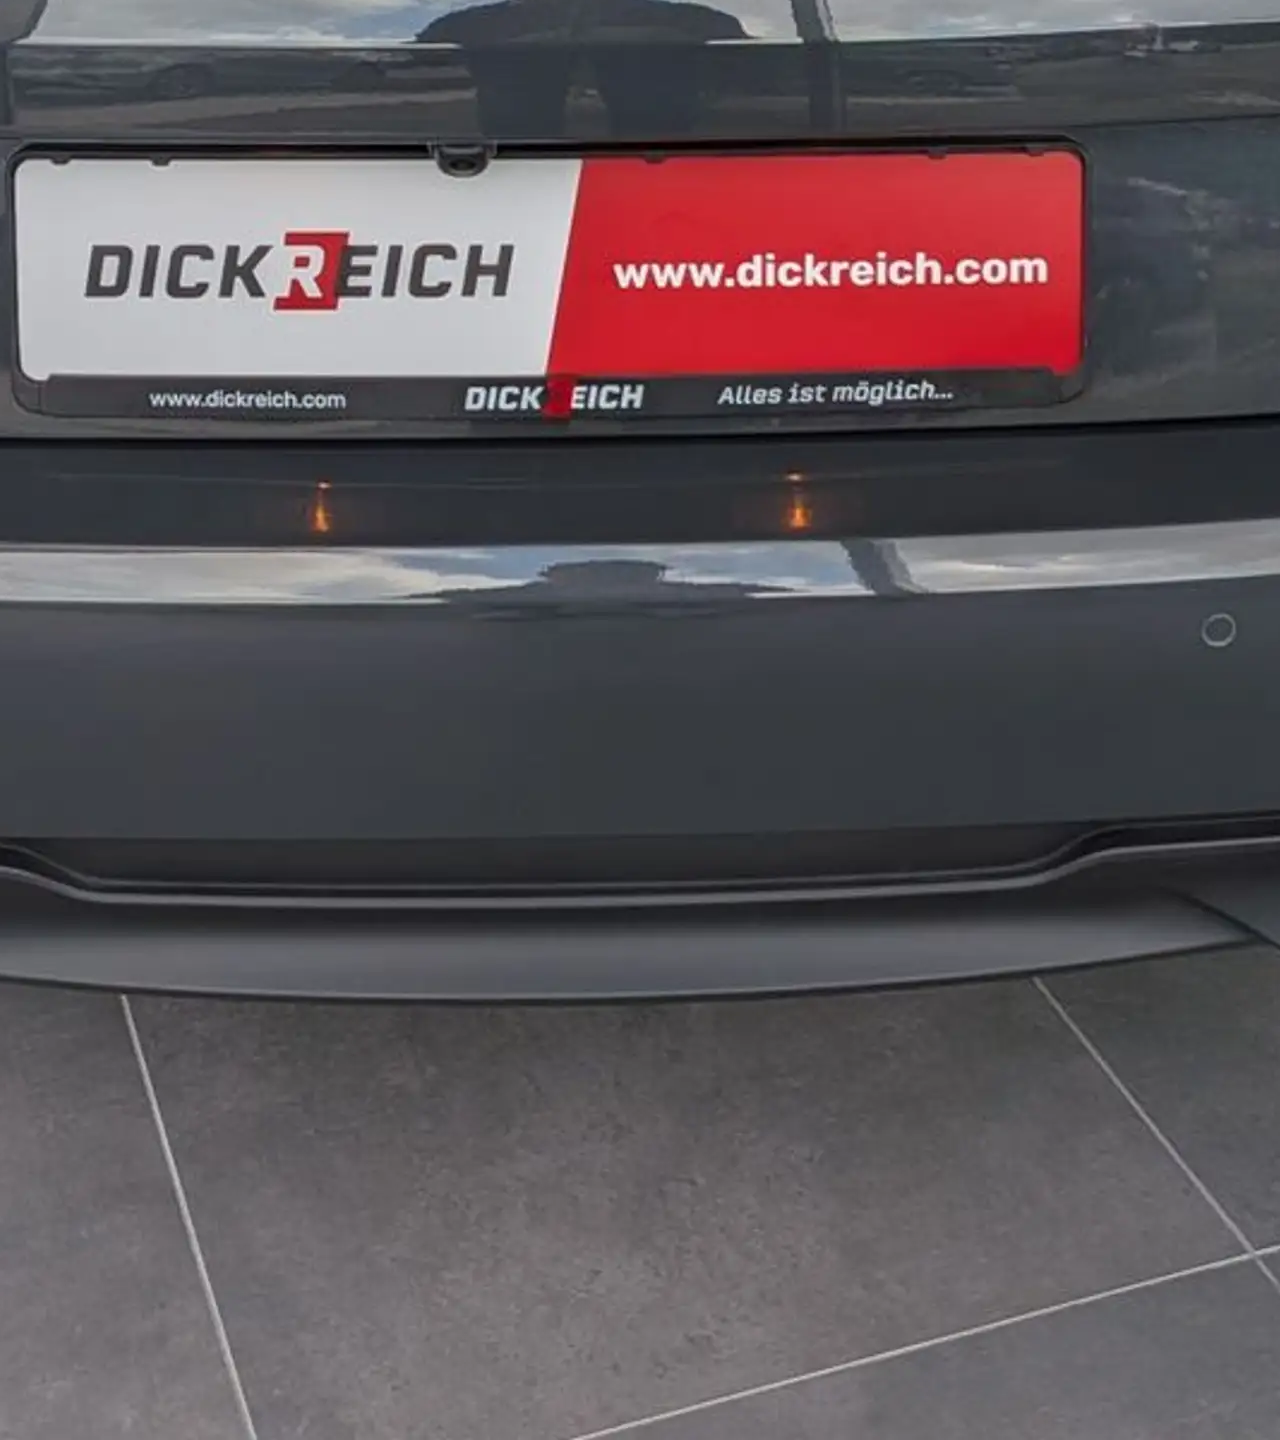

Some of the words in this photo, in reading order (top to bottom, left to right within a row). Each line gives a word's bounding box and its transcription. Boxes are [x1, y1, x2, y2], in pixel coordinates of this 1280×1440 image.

[83, 232, 516, 310] DICKREICH
[612, 252, 1049, 290] www.dickreich.com
[148, 389, 347, 410] www.dickreich.com
[463, 381, 646, 413] DICKEICH
[717, 385, 783, 405] Alles
[787, 382, 827, 403] ist
[831, 379, 954, 407] möglich...
